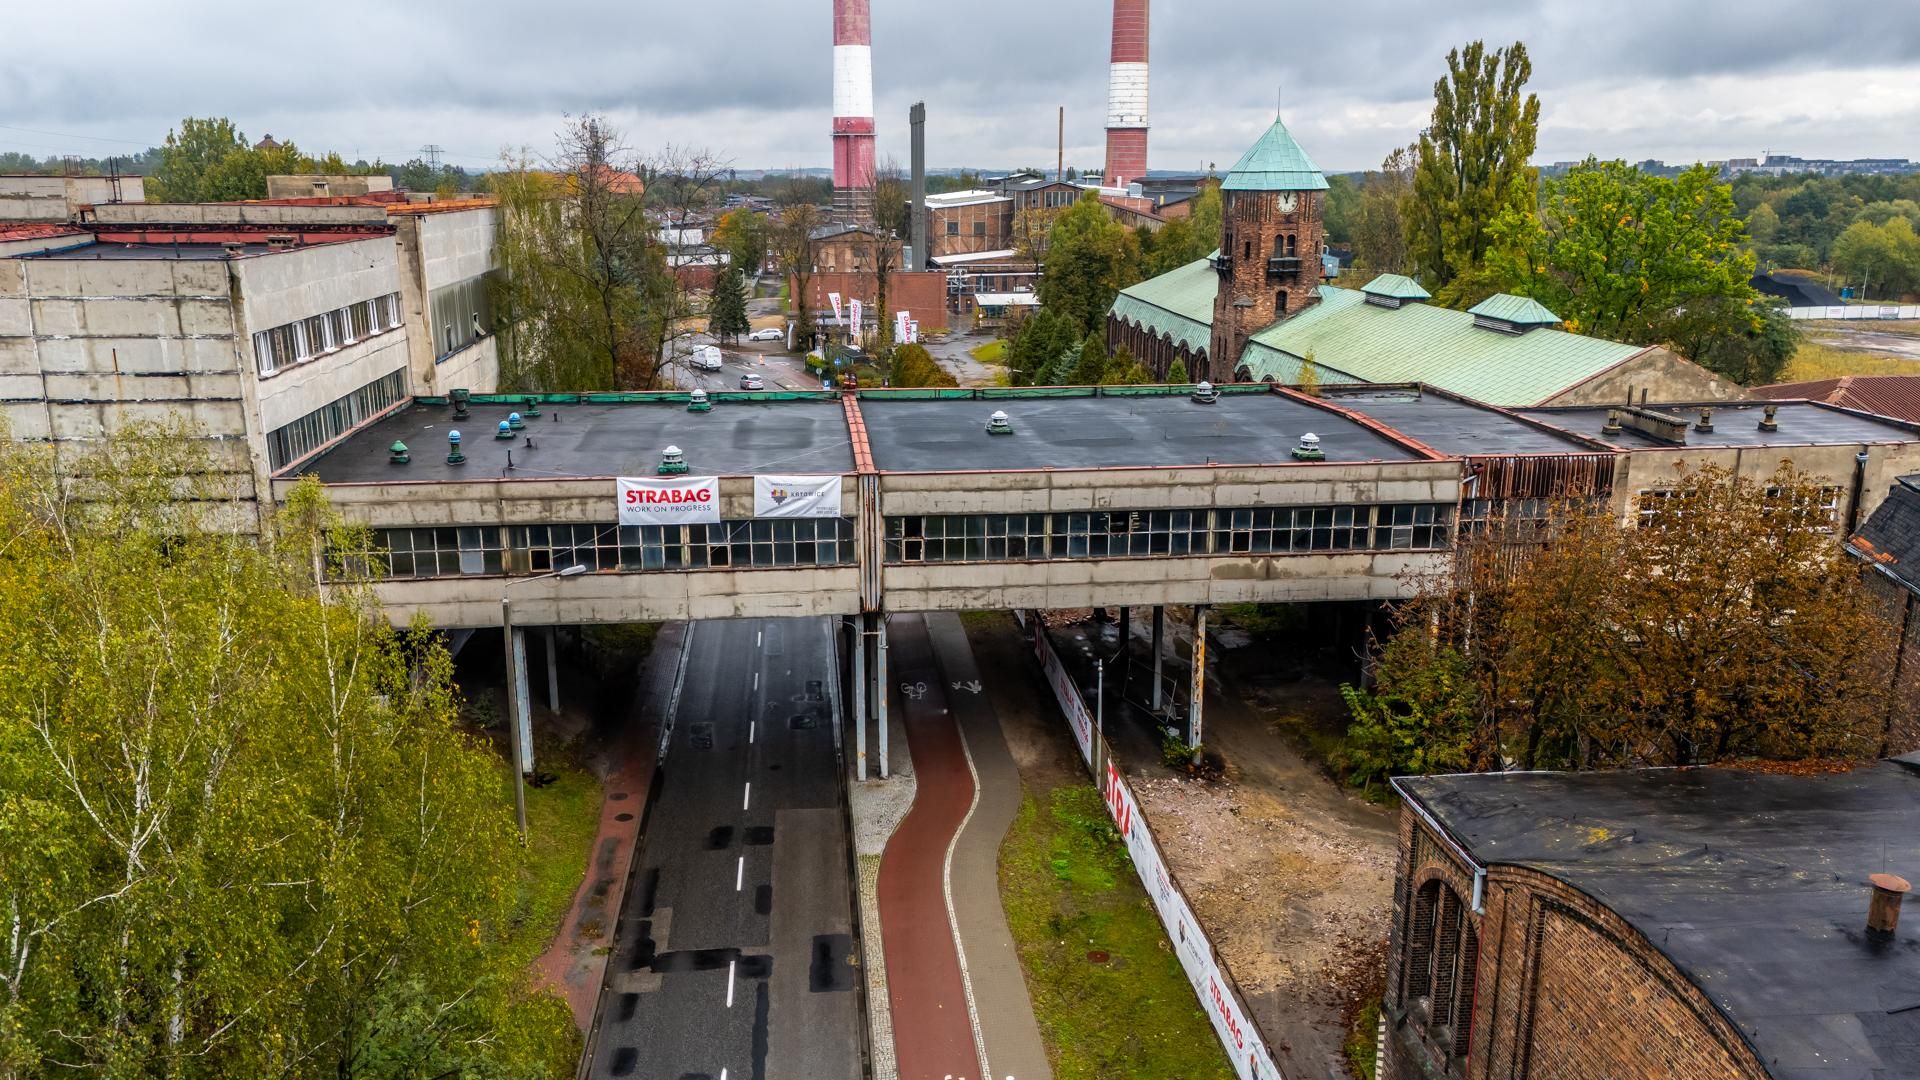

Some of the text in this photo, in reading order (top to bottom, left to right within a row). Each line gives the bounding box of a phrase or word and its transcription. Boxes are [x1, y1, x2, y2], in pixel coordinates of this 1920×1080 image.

[626, 488, 711, 503] STRABAG
[671, 504, 712, 512] PROGRESS
[1209, 975, 1243, 1050] STRABAG
